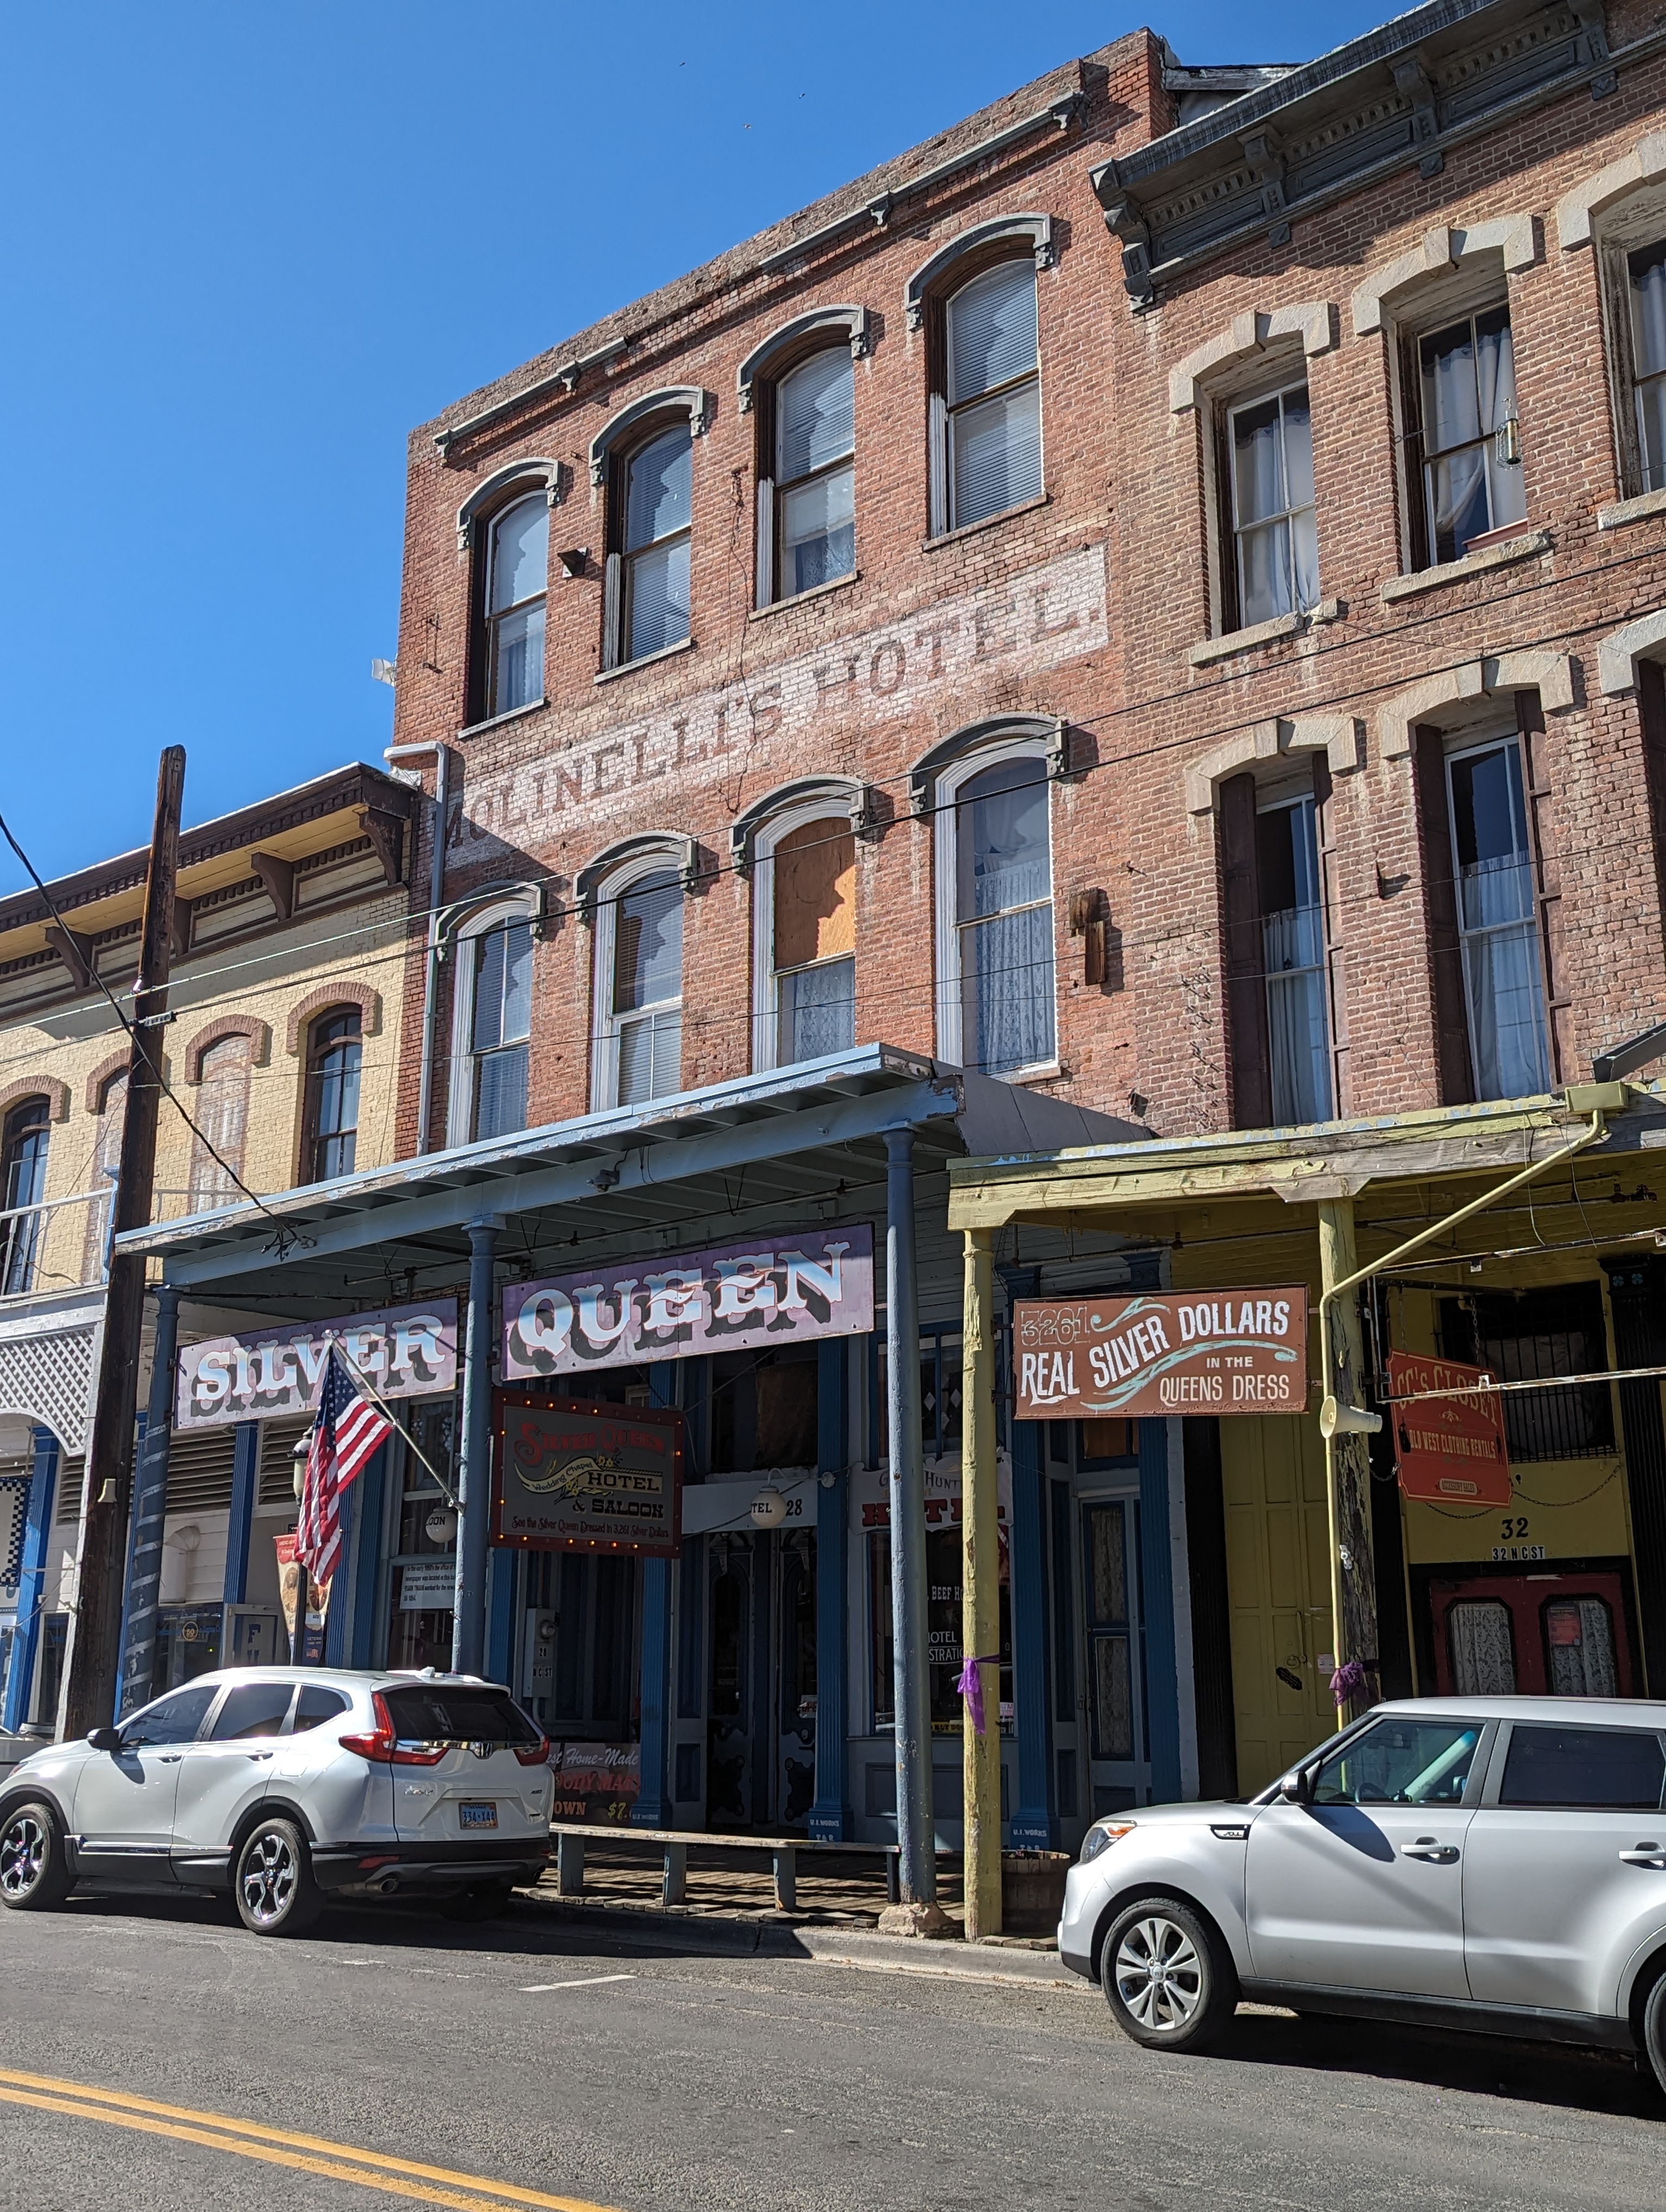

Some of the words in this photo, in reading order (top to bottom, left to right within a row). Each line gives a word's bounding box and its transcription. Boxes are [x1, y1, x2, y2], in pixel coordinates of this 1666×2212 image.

[518, 1242, 850, 1357] QUEEN
[1021, 1307, 1091, 1347] 3261
[197, 1314, 446, 1401] SILVER
[1021, 1351, 1080, 1406] REAL
[1089, 1316, 1170, 1388] SILVER
[1177, 1301, 1290, 1341] DOLLARS
[1206, 1358, 1220, 1368] IN
[1225, 1356, 1253, 1368] THE
[1160, 1377, 1222, 1406] QUEENS
[1232, 1375, 1289, 1400] DRESS
[1433, 1365, 1497, 1426] CLOSET
[514, 1422, 596, 1465] SILVER
[599, 1423, 665, 1454] QUEEN
[1409, 1429, 1421, 1449] OLD
[1422, 1431, 1440, 1451] WEST
[1441, 1434, 1470, 1455] CLOTHING
[1471, 1438, 1496, 1458] RENTALS
[533, 1475, 566, 1491] Wedding
[566, 1462, 593, 1476] Chapel
[588, 1472, 659, 1491] HOTEL
[573, 1500, 585, 1512] &
[592, 1499, 664, 1518] SALOON
[751, 1503, 772, 1513] TEL
[786, 1499, 802, 1516] 28
[427, 1516, 445, 1525] OON
[512, 1516, 525, 1529] See
[527, 1517, 536, 1528] the
[538, 1517, 556, 1530] Silver
[559, 1519, 578, 1534] Queen
[580, 1521, 605, 1533] Dressed
[631, 1525, 647, 1536] Silver
[649, 1527, 669, 1538] Dollars
[1502, 1517, 1528, 1539] 32
[1493, 1548, 1507, 1560] 32
[1511, 1547, 1517, 1559] N
[1522, 1547, 1528, 1559] C
[1531, 1546, 1544, 1558] ST
[932, 1585, 952, 1600] BEEF
[540, 1648, 547, 1656] 28
[929, 1648, 963, 1661] STRATI
[545, 1668, 552, 1676] ST
[547, 1751, 563, 1764] est
[566, 1747, 639, 1766] Home-Made
[554, 1801, 587, 1815] OWN
